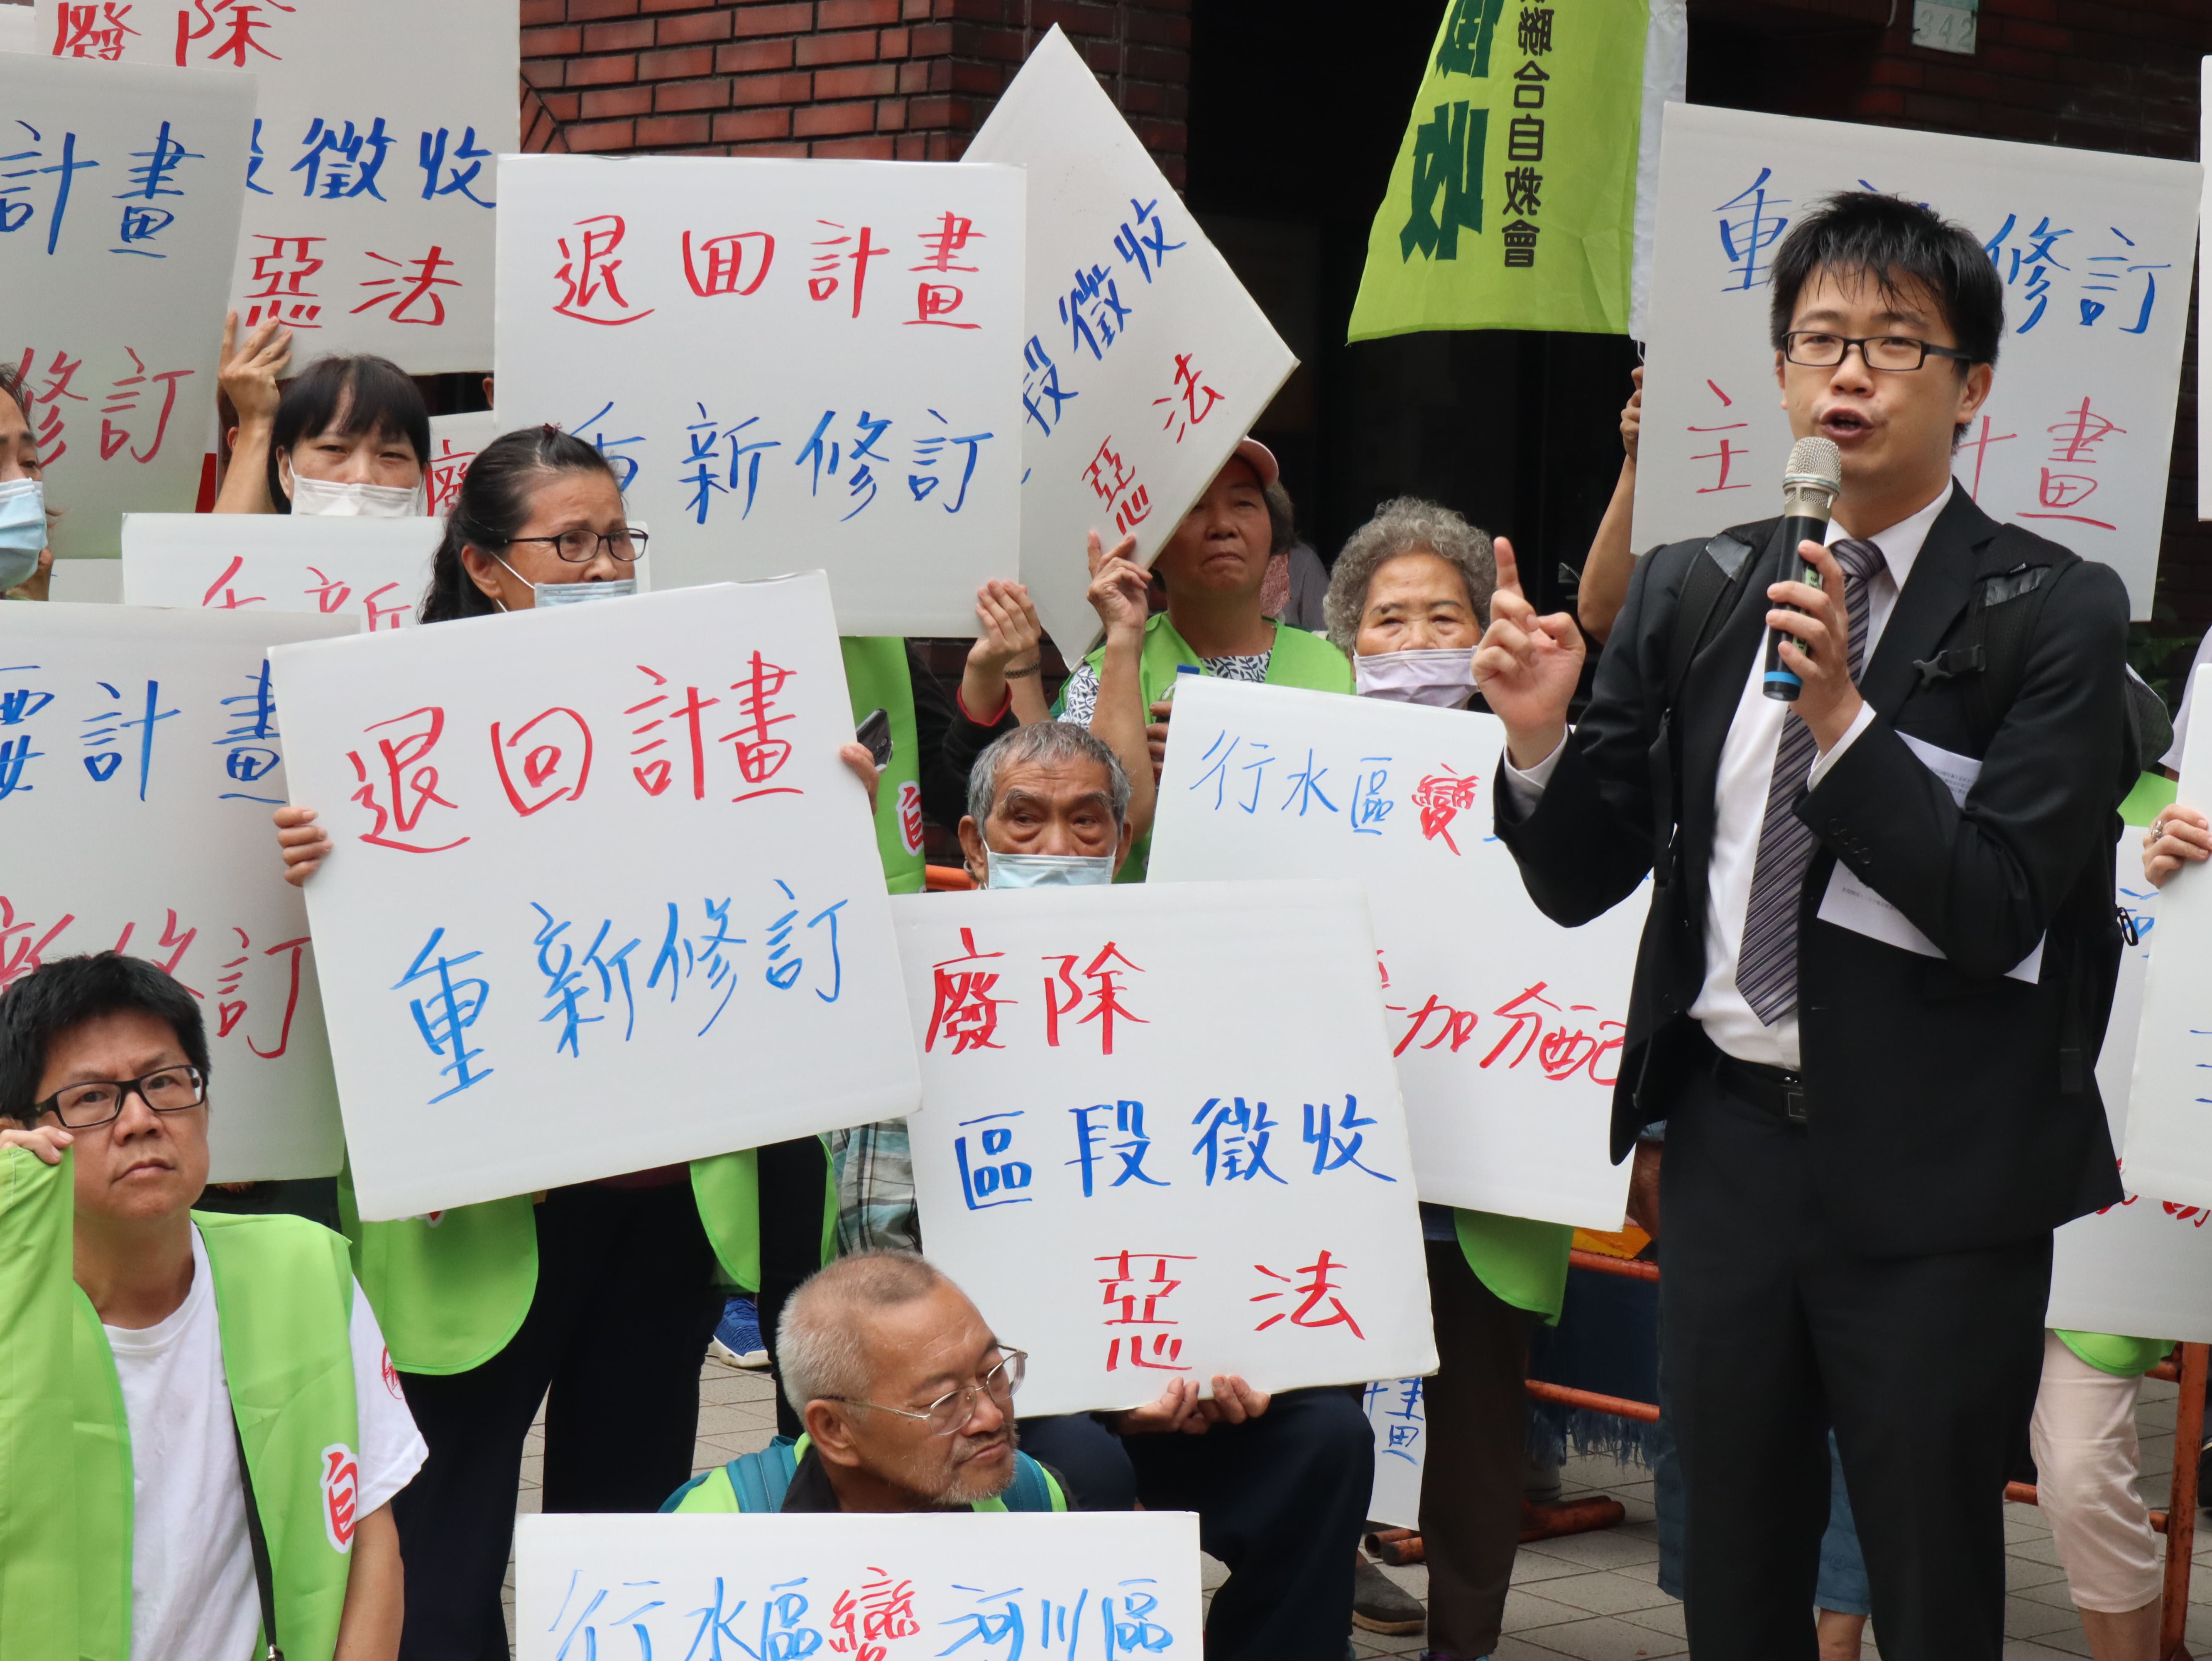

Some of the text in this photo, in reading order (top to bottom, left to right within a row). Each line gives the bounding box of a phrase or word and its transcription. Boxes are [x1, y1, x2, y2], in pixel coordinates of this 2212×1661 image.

[53, 0, 297, 67] 廢除
[1916, 8, 1973, 48] 342
[244, 234, 462, 328] 惡法
[1712, 168, 2172, 334] 重修訂
[1021, 198, 1187, 485] 段徵收
[1082, 353, 1225, 536] 惡法
[345, 650, 804, 854] 退回計畫
[1190, 729, 1495, 857] 行水區變
[389, 879, 849, 1105] 重新修訂
[925, 928, 1149, 1056] 廢除
[1377, 950, 1626, 1086] 加分配
[955, 1093, 1397, 1211] 區段徵收
[1095, 1249, 1366, 1373] 惡法
